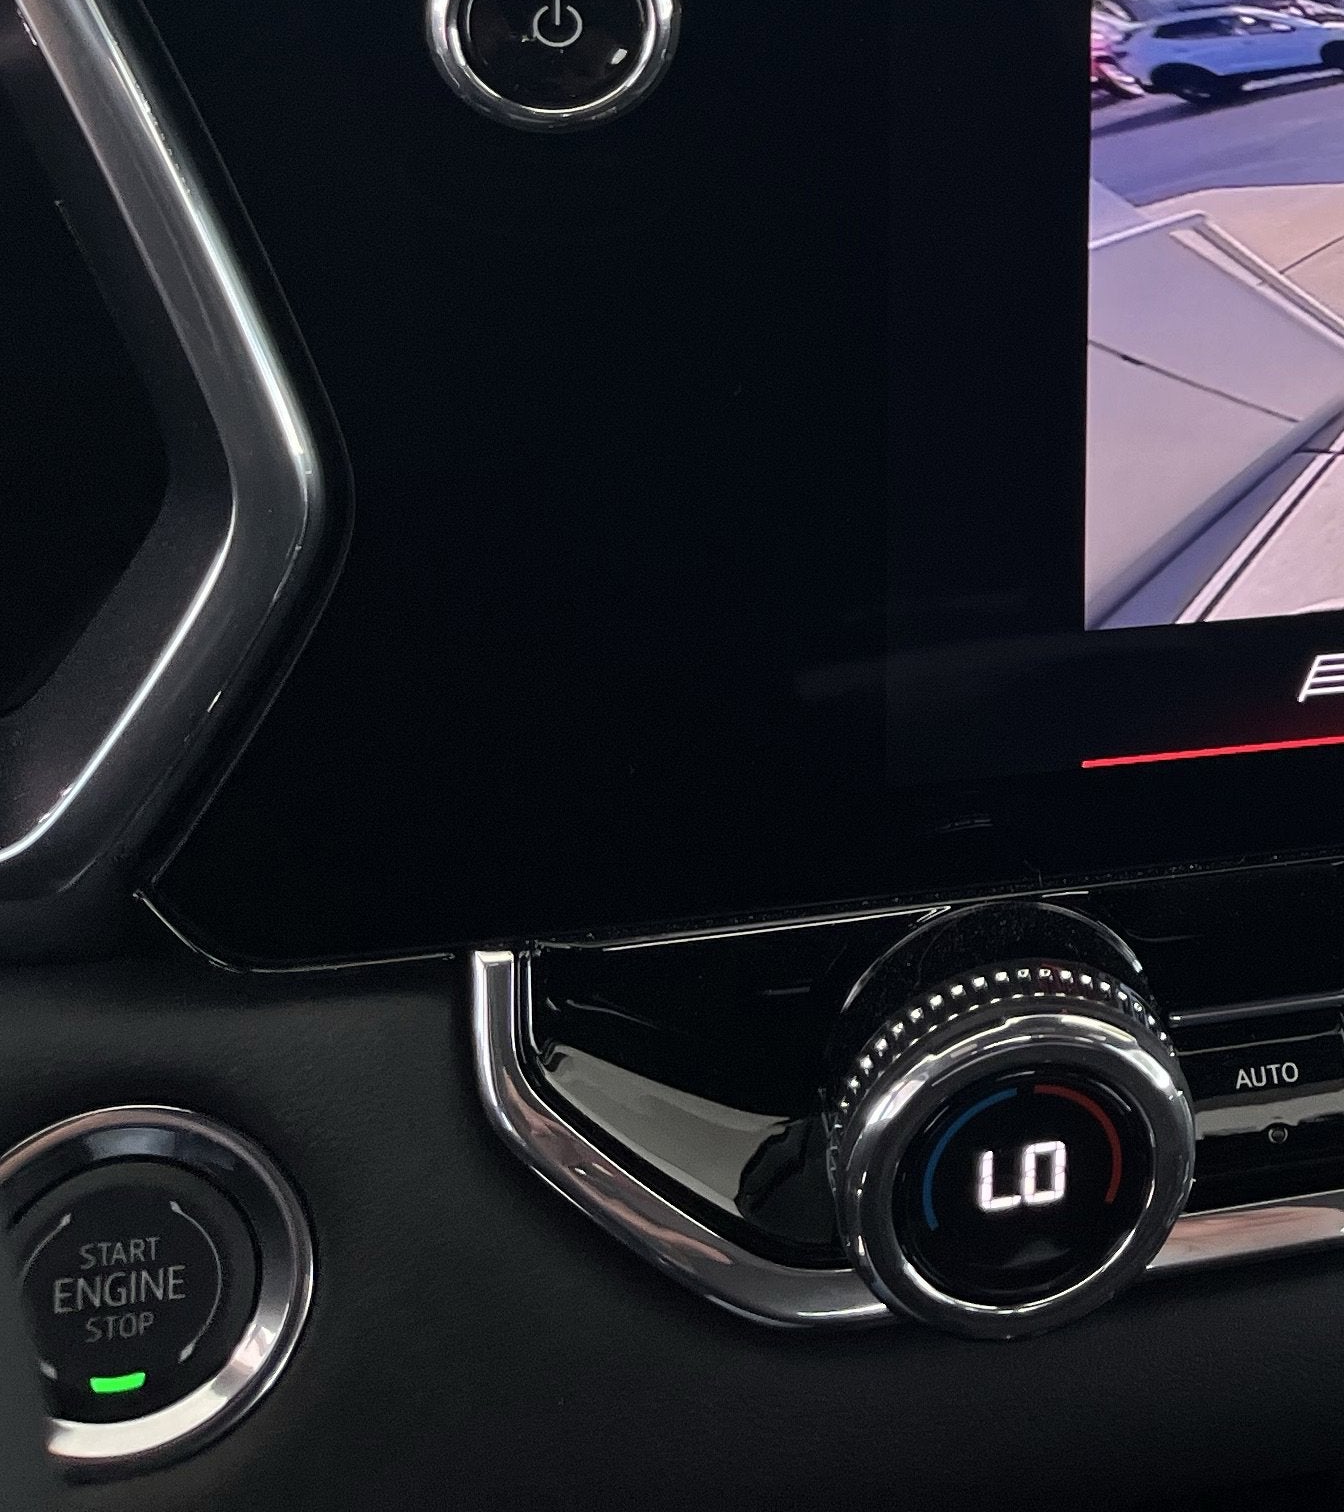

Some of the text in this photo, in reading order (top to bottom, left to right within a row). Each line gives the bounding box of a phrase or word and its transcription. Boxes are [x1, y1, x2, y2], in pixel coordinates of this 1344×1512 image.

[1235, 1061, 1299, 1090] AUTO
[977, 1140, 1067, 1212] LO
[79, 1236, 161, 1270] START
[52, 1265, 186, 1315] ENGINE
[84, 1311, 154, 1343] STOP
